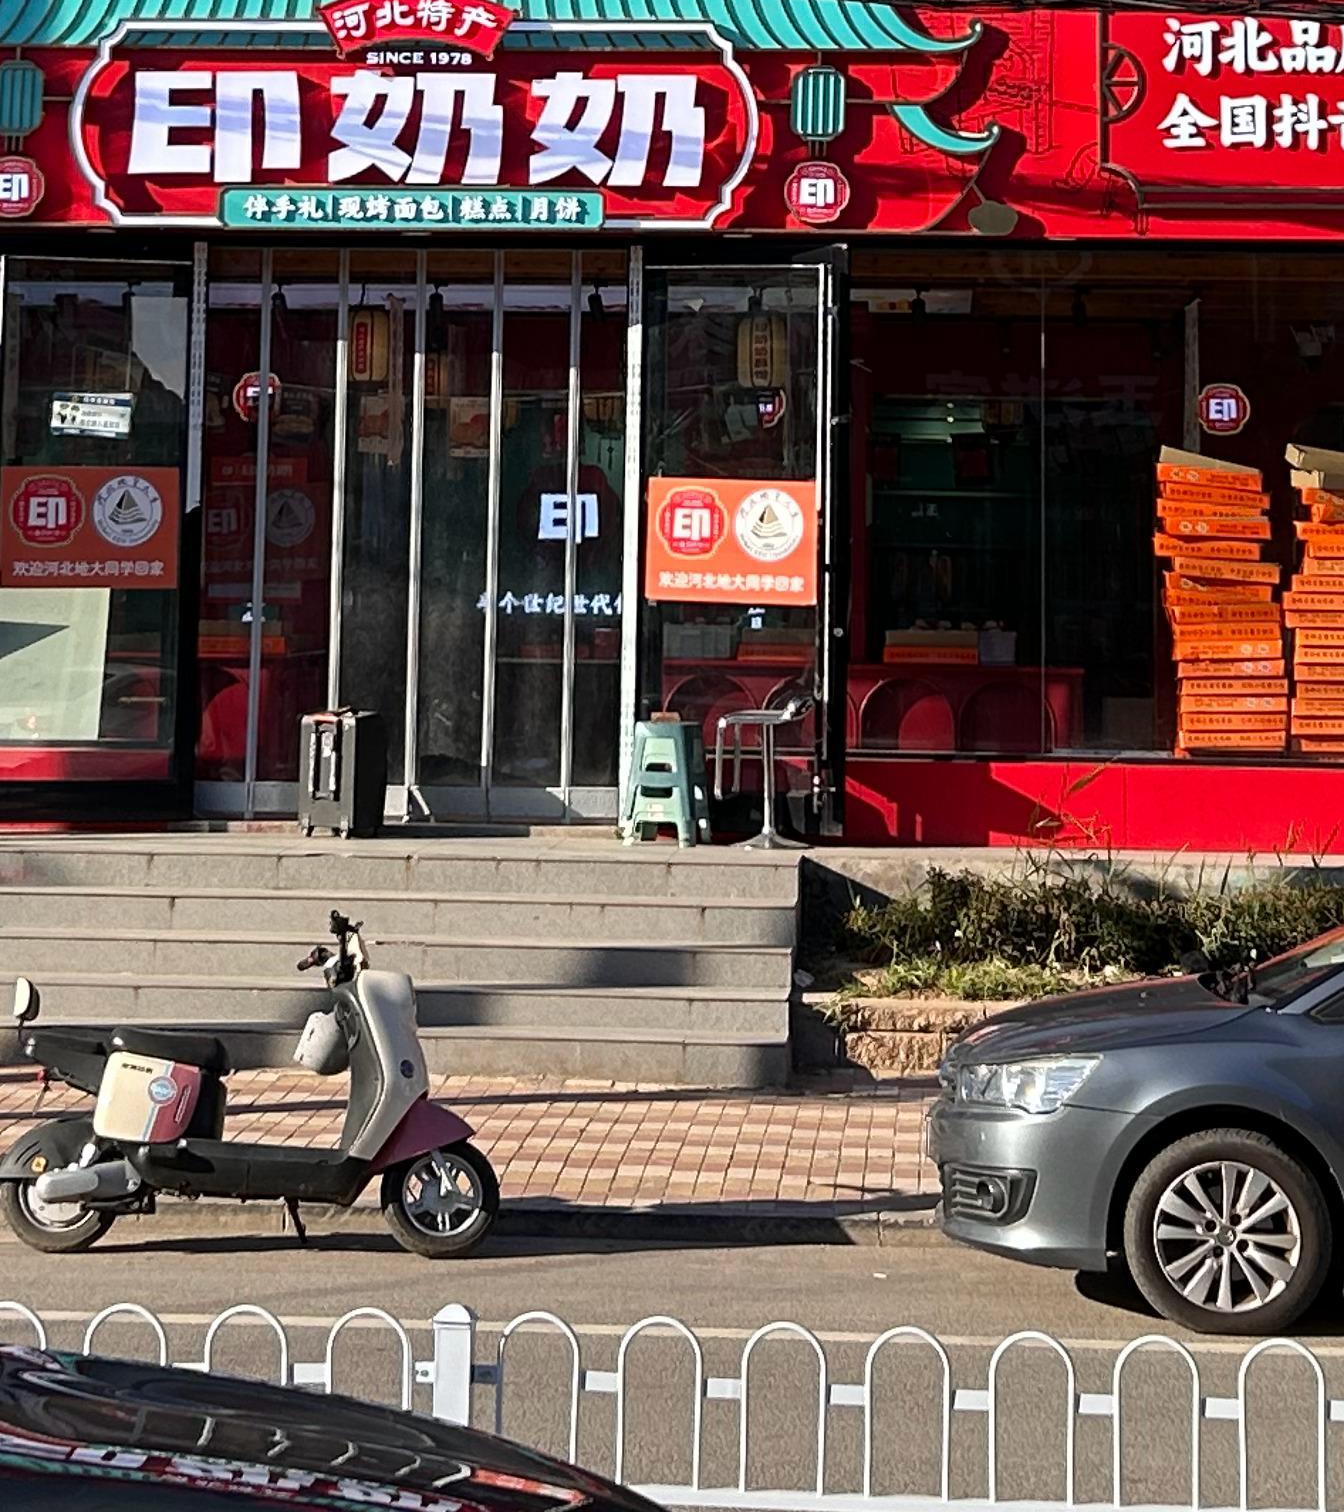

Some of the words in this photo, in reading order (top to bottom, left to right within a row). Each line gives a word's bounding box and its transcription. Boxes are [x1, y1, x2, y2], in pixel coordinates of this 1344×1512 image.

[366, 51, 424, 65] SINCE
[429, 52, 472, 65] 1978
[127, 69, 706, 187] 印奶奶
